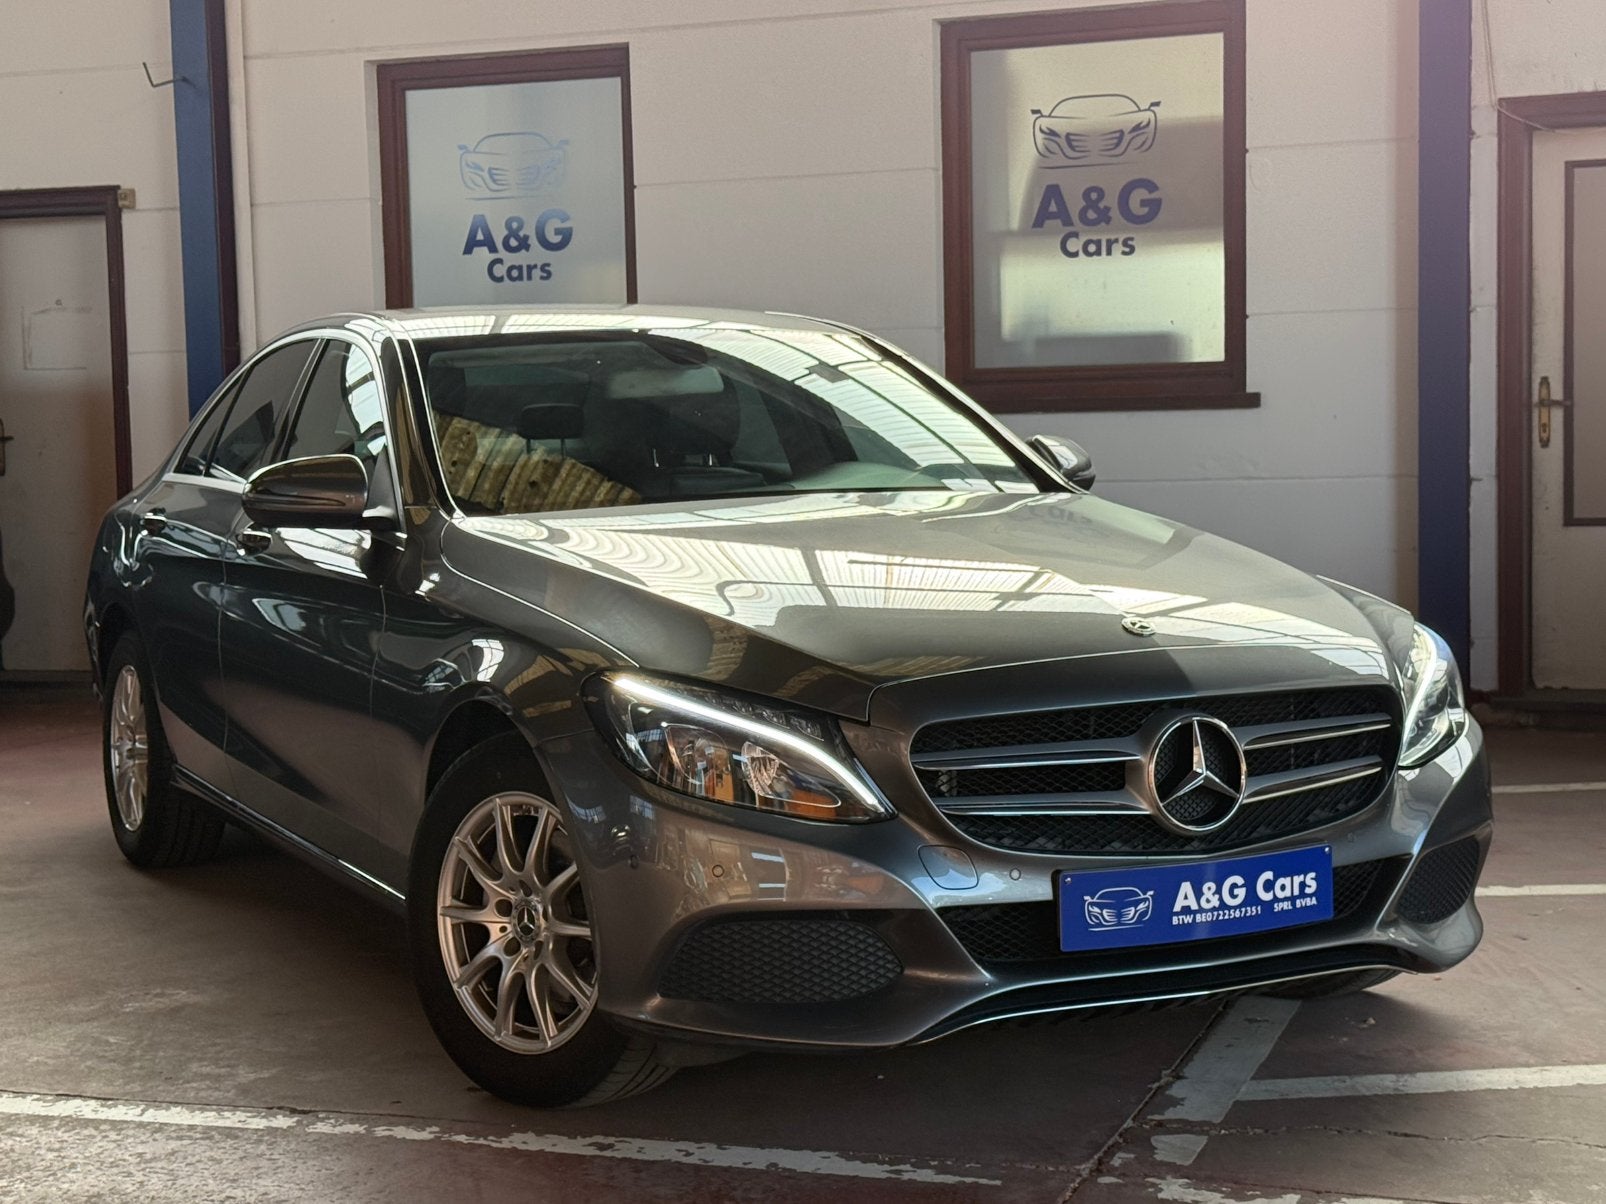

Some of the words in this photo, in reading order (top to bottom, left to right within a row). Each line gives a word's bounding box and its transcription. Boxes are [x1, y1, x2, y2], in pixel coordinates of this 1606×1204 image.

[1031, 178, 1163, 229] A&G
[462, 208, 573, 256] A&G
[1059, 231, 1136, 259] Cars
[487, 257, 552, 283] Cars
[1172, 875, 1247, 913] A&G
[1256, 870, 1318, 901] Cars
[1172, 914, 1194, 925] BTW
[1195, 905, 1262, 924] BE0722567351
[1273, 900, 1293, 912] SPRL
[1296, 897, 1318, 909] BVBA
